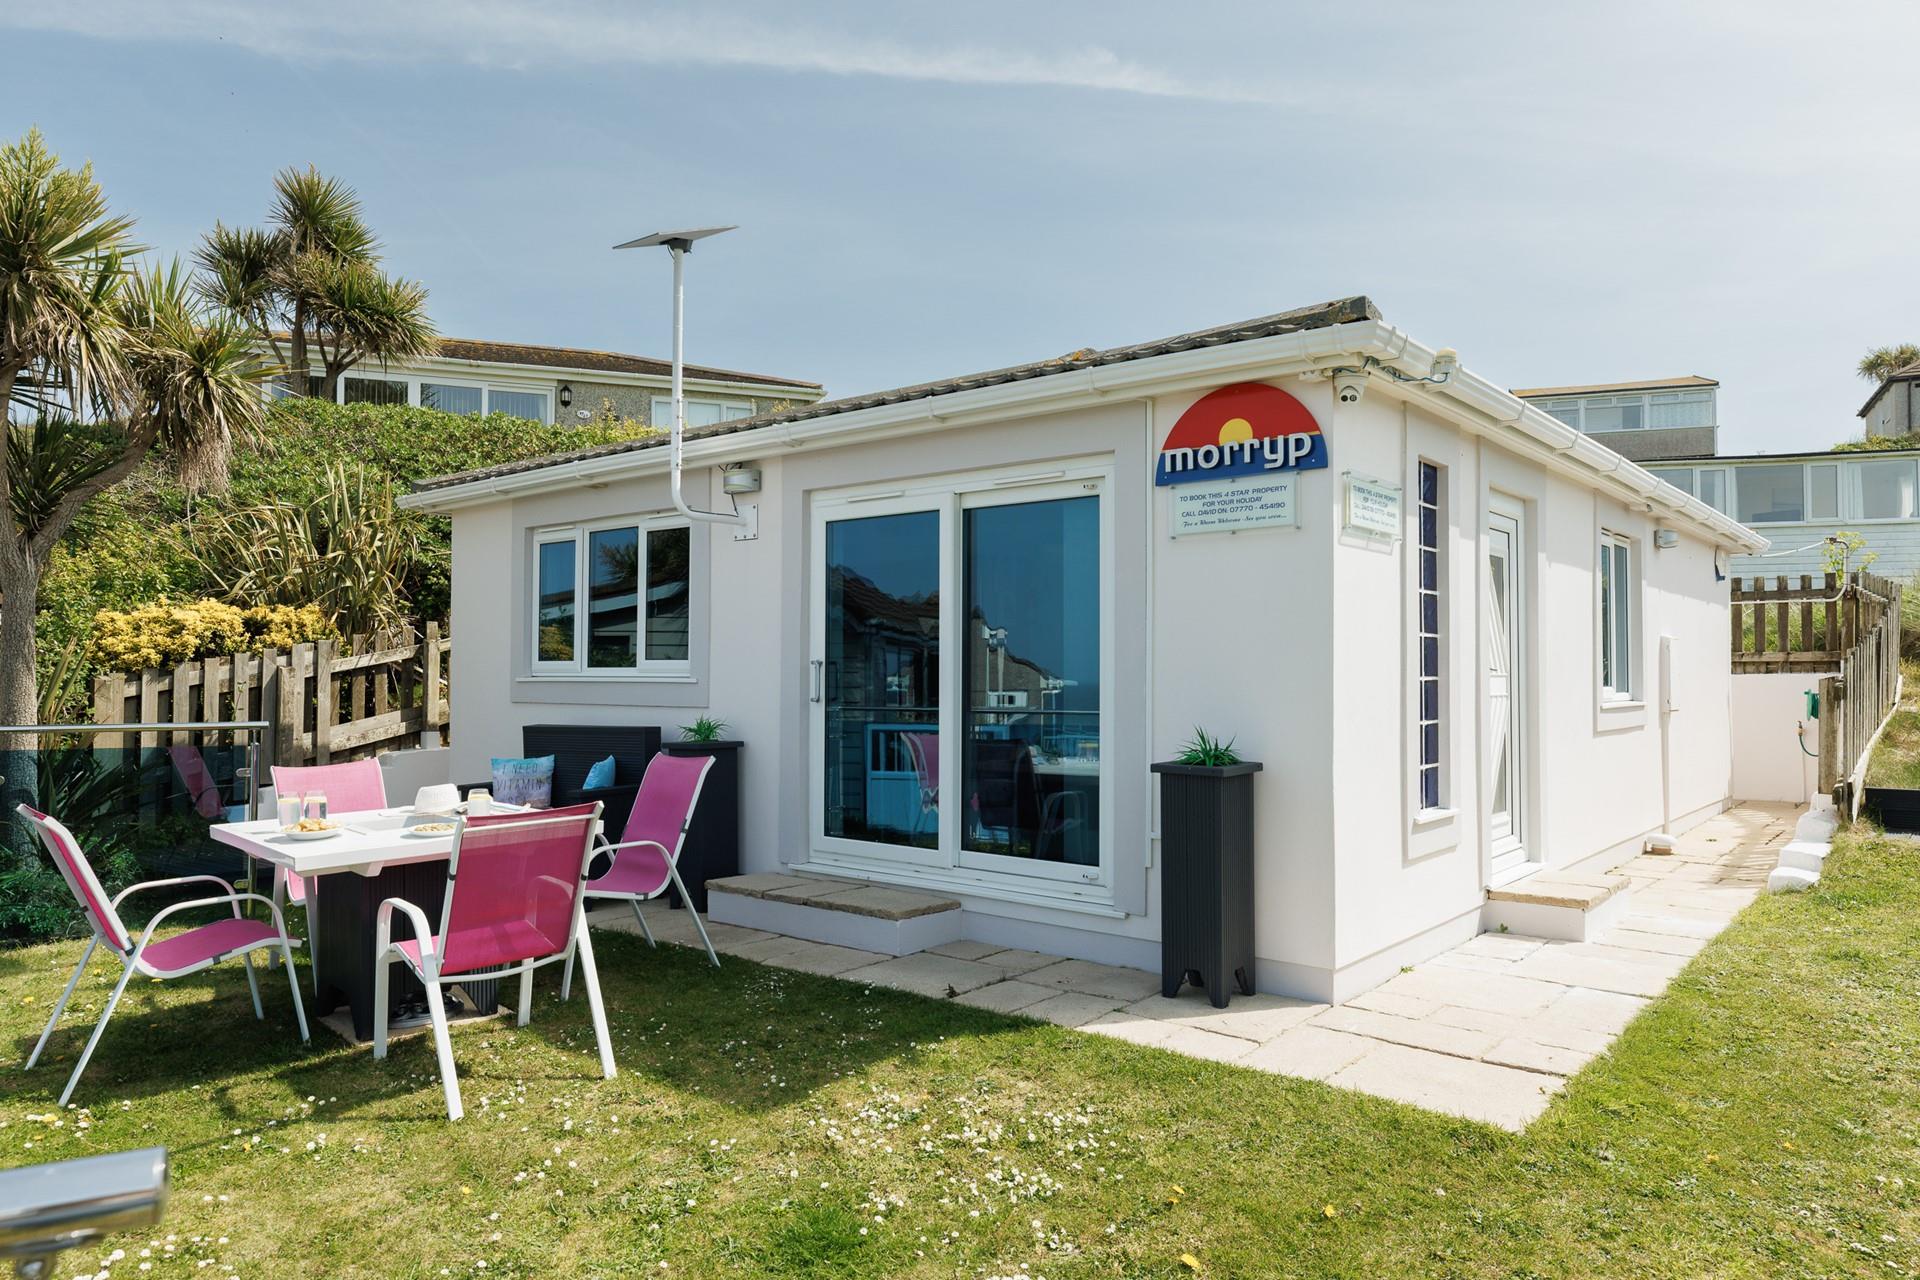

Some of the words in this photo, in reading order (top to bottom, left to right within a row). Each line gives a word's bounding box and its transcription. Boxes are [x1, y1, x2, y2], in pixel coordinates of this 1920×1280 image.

[1165, 433, 1312, 473] morryp
[1189, 494, 1207, 502] BOOK
[1208, 491, 1223, 499] THIS
[1231, 489, 1250, 497] STAR
[1252, 485, 1288, 495] PROPERTY
[1202, 500, 1216, 508] FOR
[1217, 498, 1235, 506] YOUR
[1236, 496, 1263, 504] HOLIDAY
[1181, 510, 1196, 518] CALL
[1198, 508, 1217, 516] DAVID
[1229, 504, 1254, 513] 07770
[496, 778, 544, 791] VITAMIN
